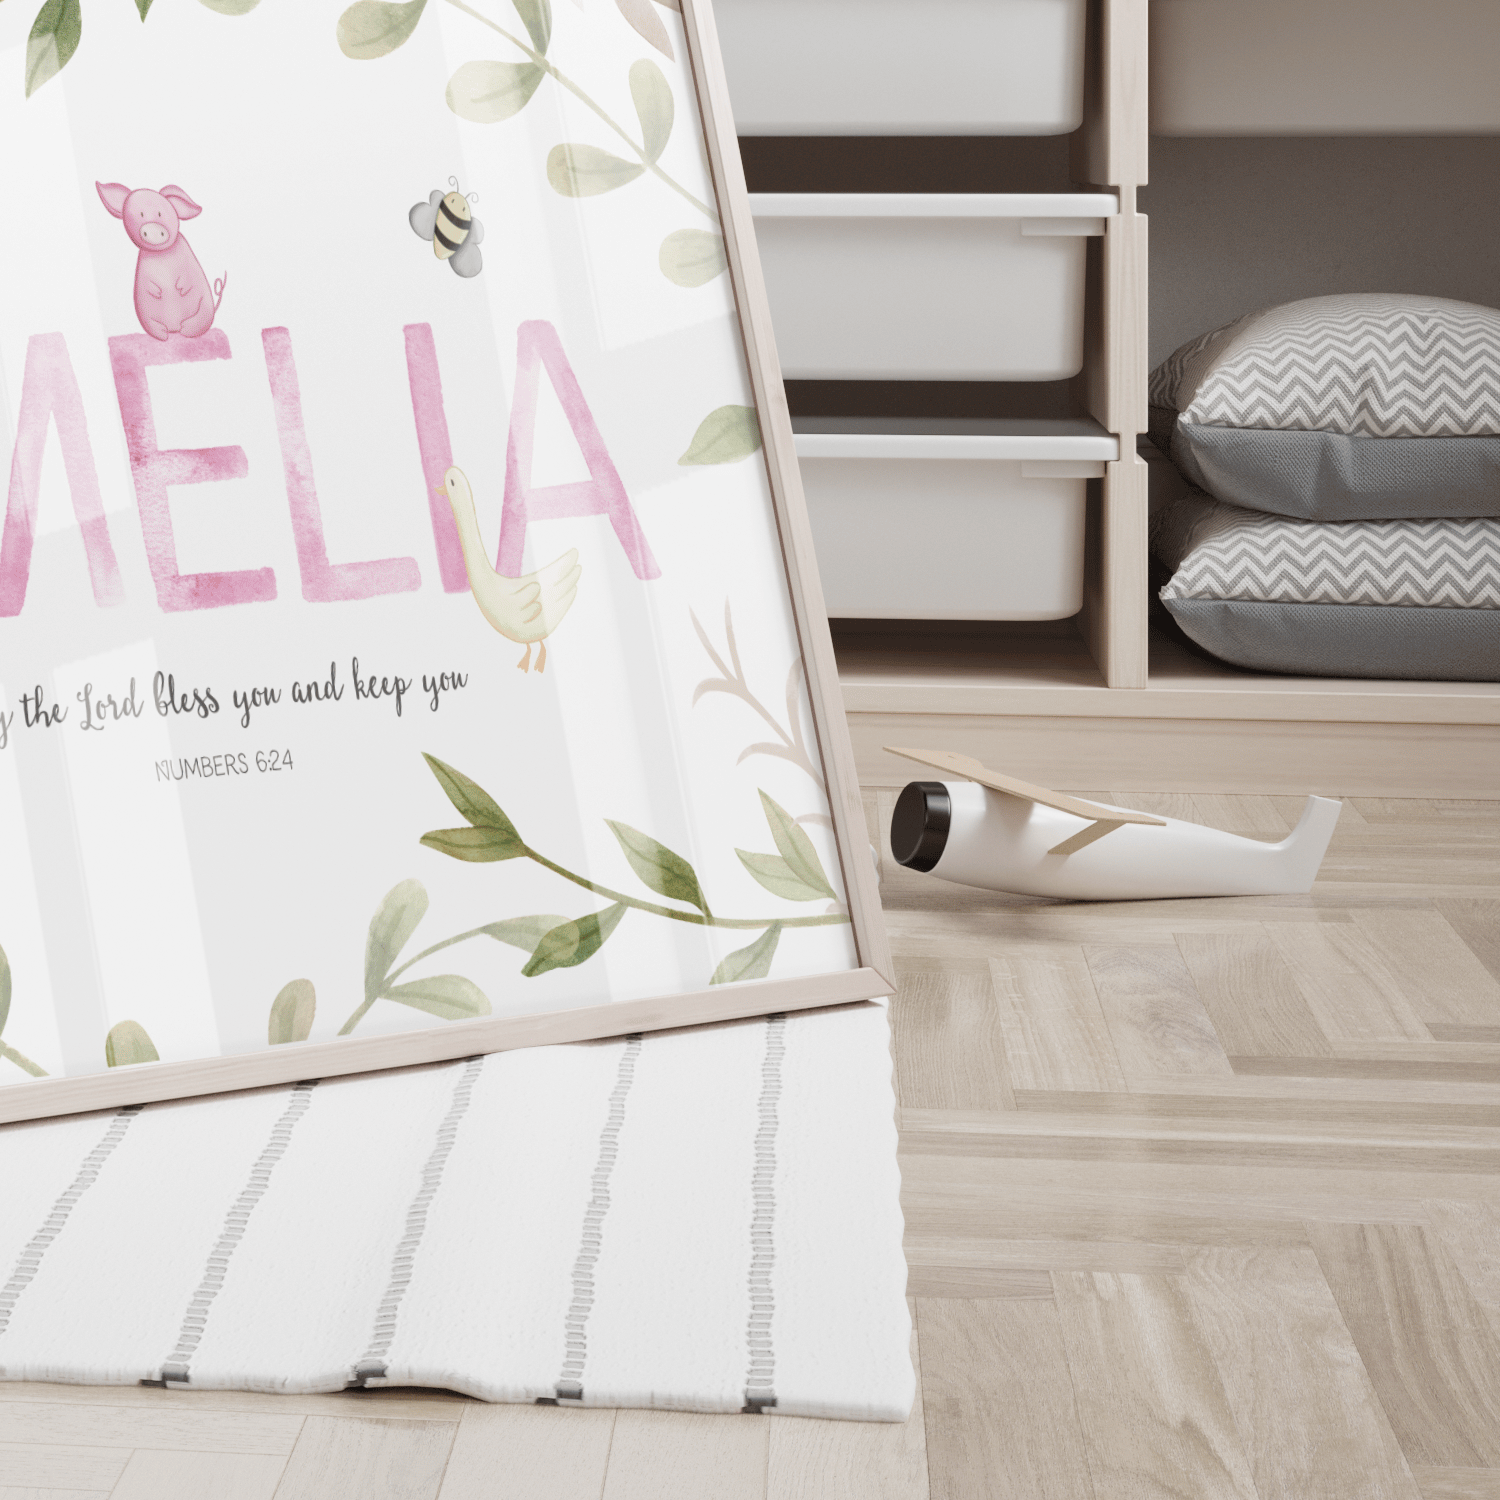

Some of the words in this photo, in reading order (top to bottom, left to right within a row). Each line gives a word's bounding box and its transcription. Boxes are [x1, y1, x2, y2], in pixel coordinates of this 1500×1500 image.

[19, 684, 68, 728] the
[76, 676, 144, 731] Lord
[153, 670, 220, 719] bless
[233, 686, 282, 729] you
[291, 661, 345, 704] and
[352, 656, 412, 717] keep
[422, 671, 469, 712] you
[155, 752, 249, 782] NUMBERS
[255, 748, 294, 773] 6:24
